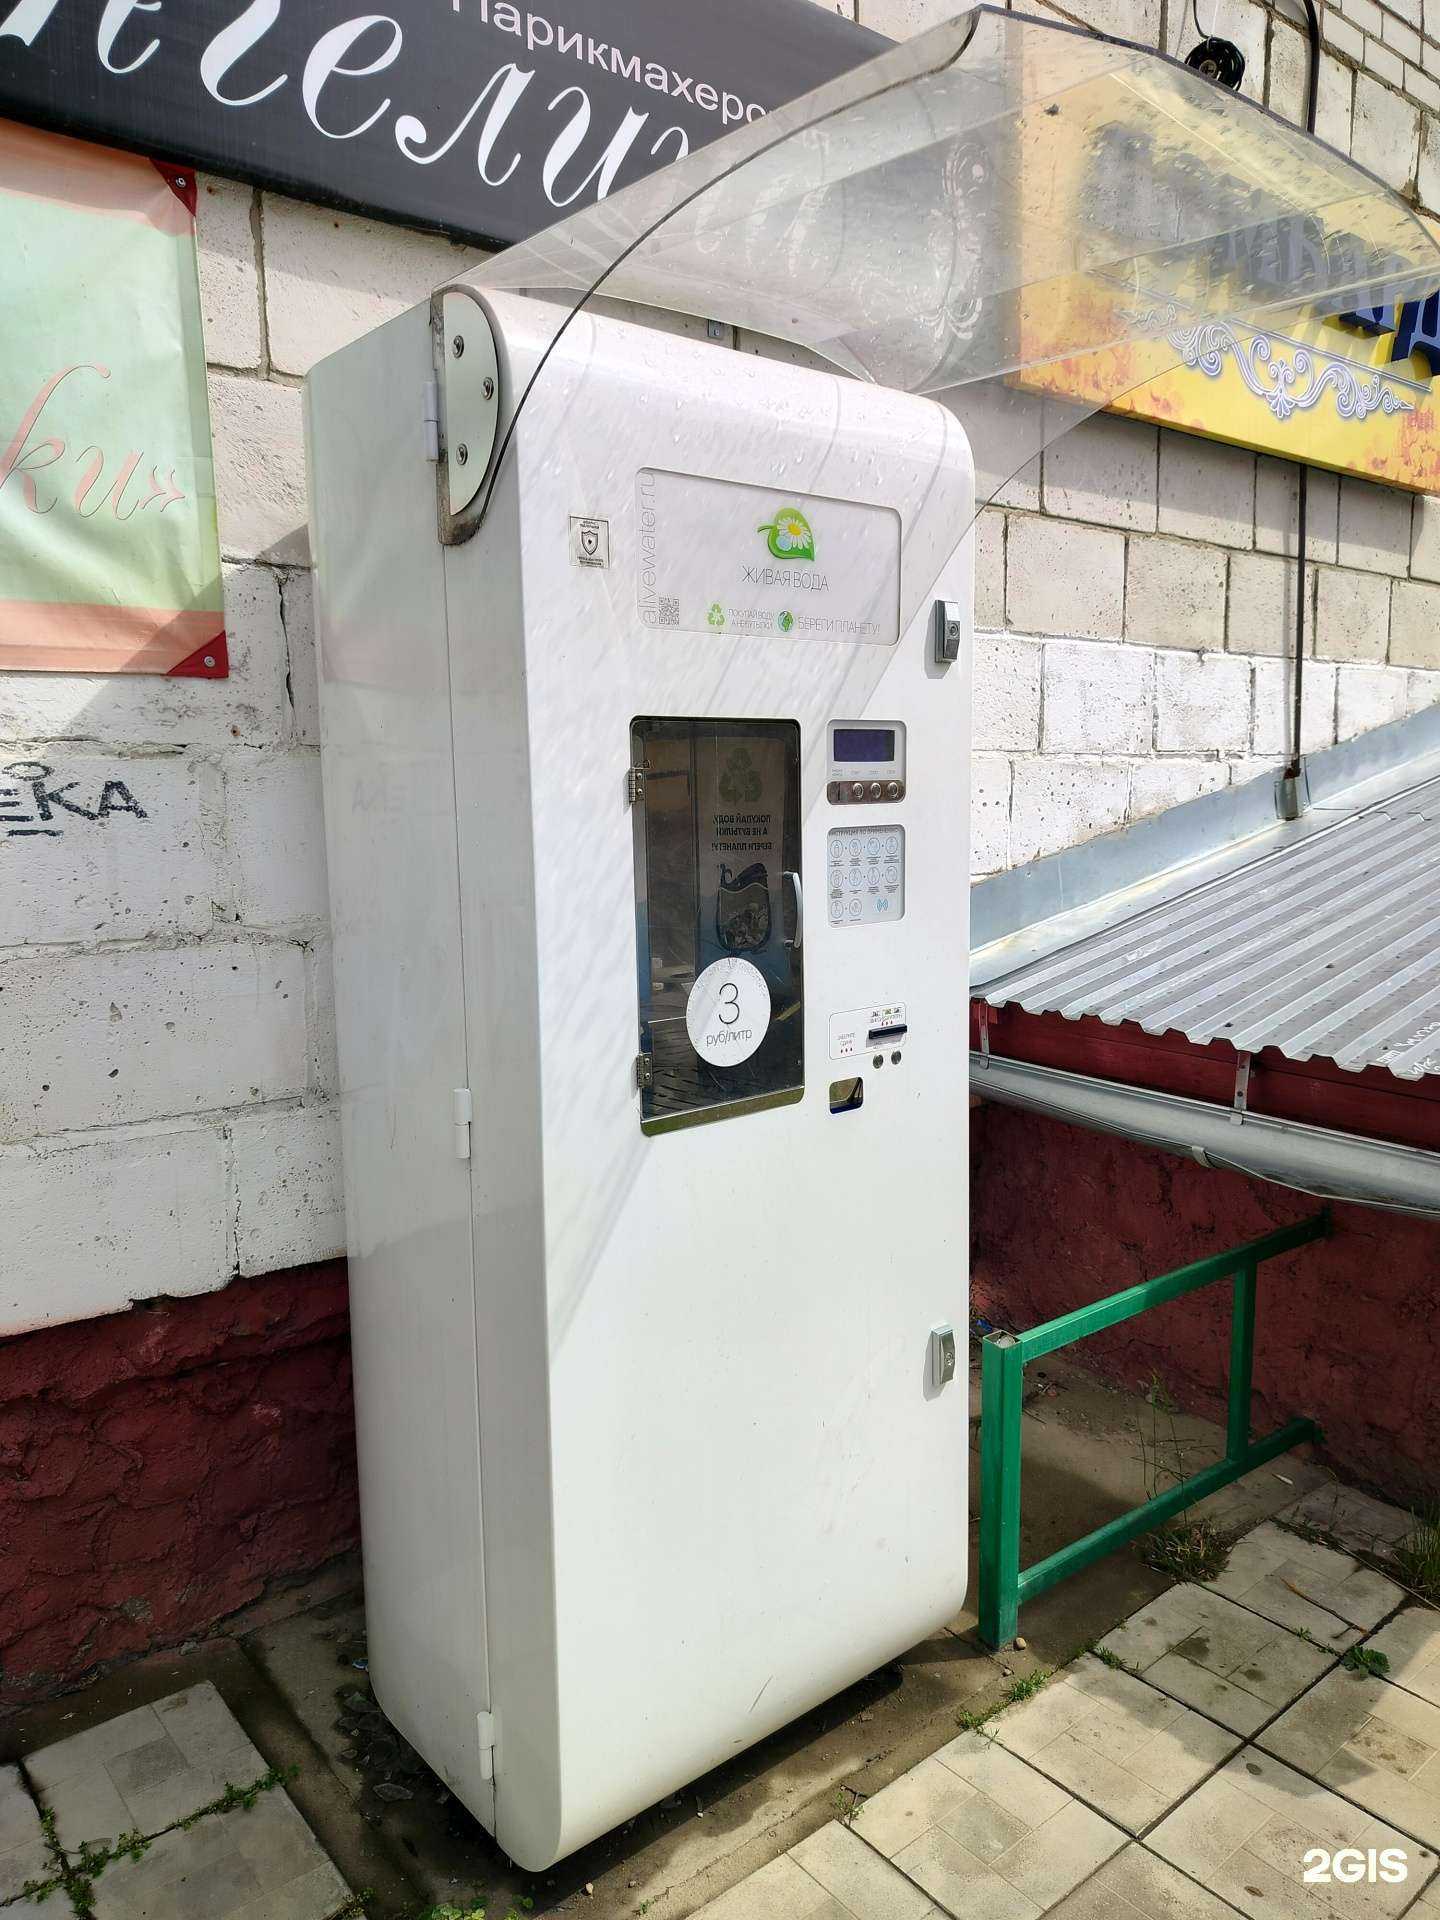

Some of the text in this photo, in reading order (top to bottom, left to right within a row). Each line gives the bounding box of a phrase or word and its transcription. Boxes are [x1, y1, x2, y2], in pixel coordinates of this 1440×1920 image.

[742, 565, 829, 592] ЖИВАЯ ВОДА
[799, 616, 834, 632] БЕРЕГИ
[718, 982, 740, 1025] 3
[706, 1029, 753, 1047] руб/литр
